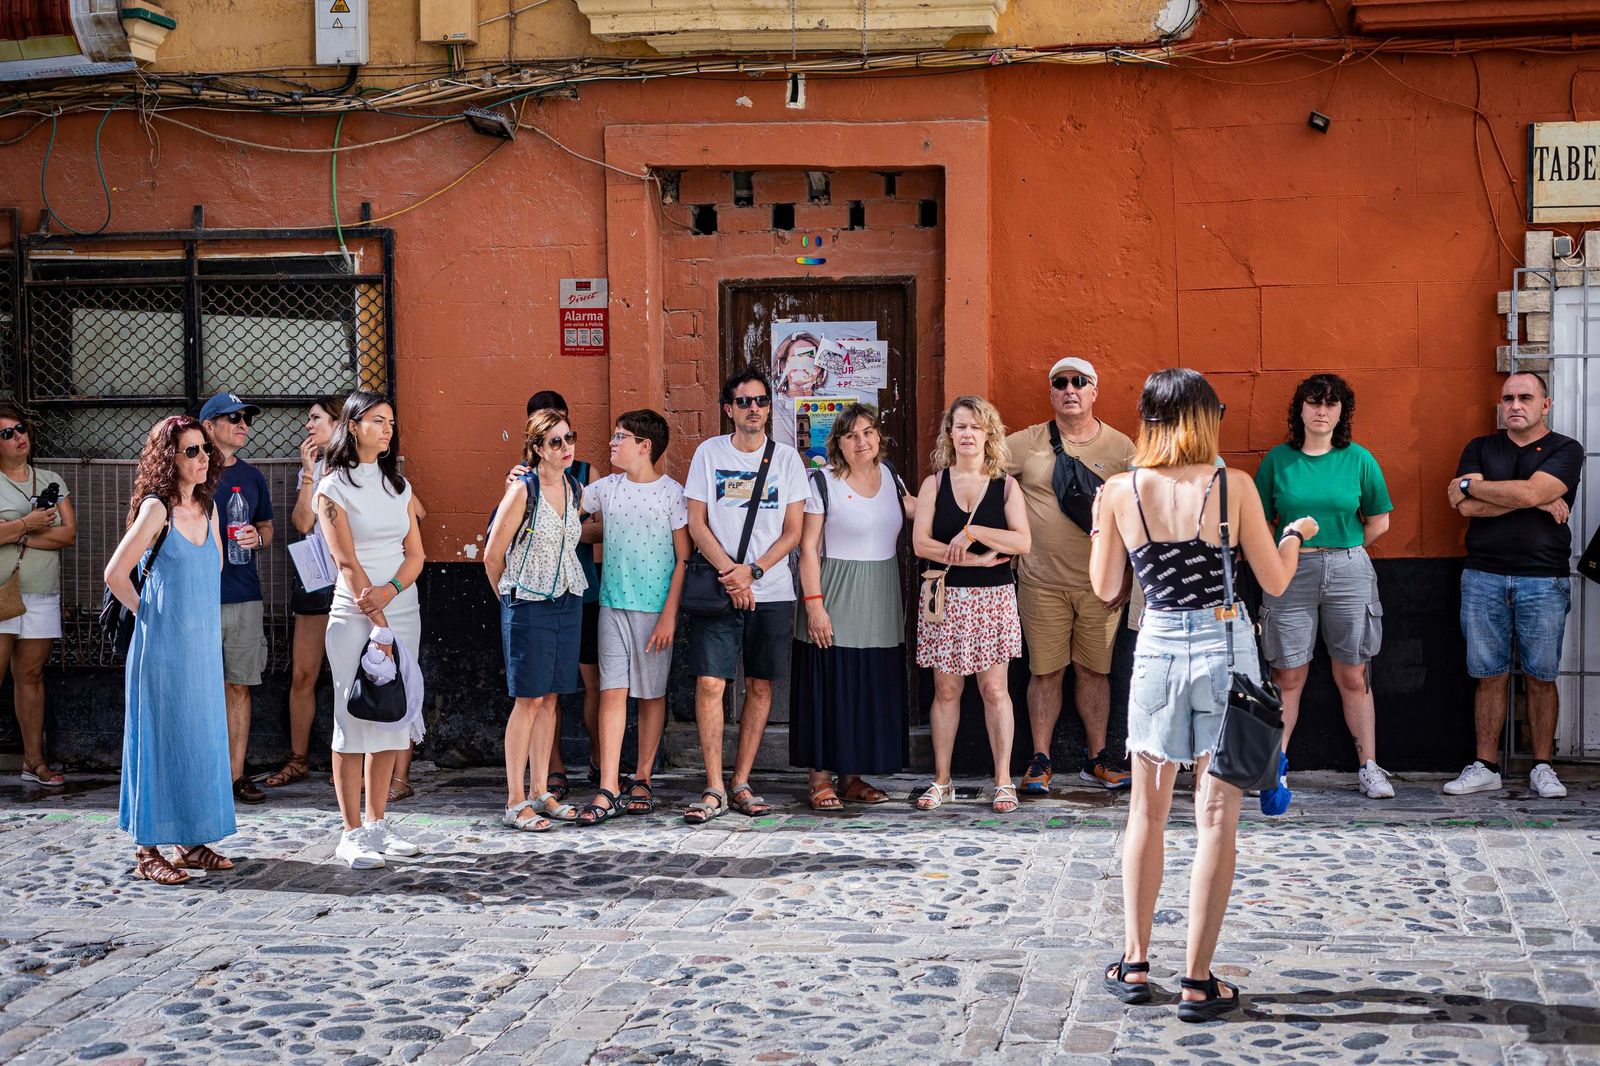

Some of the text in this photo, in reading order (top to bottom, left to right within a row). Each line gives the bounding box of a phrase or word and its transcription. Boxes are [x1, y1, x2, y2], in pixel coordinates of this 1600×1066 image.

[1534, 145, 1600, 182] TABE
[568, 291, 599, 305] Direct
[564, 311, 604, 321] Alarma
[1159, 548, 1181, 561] fresh
[1185, 554, 1207, 566] fresh
[1157, 567, 1177, 581] fresh
[1181, 573, 1203, 584] fresh
[1156, 586, 1175, 599] fresh
[1177, 593, 1198, 606] fresh
